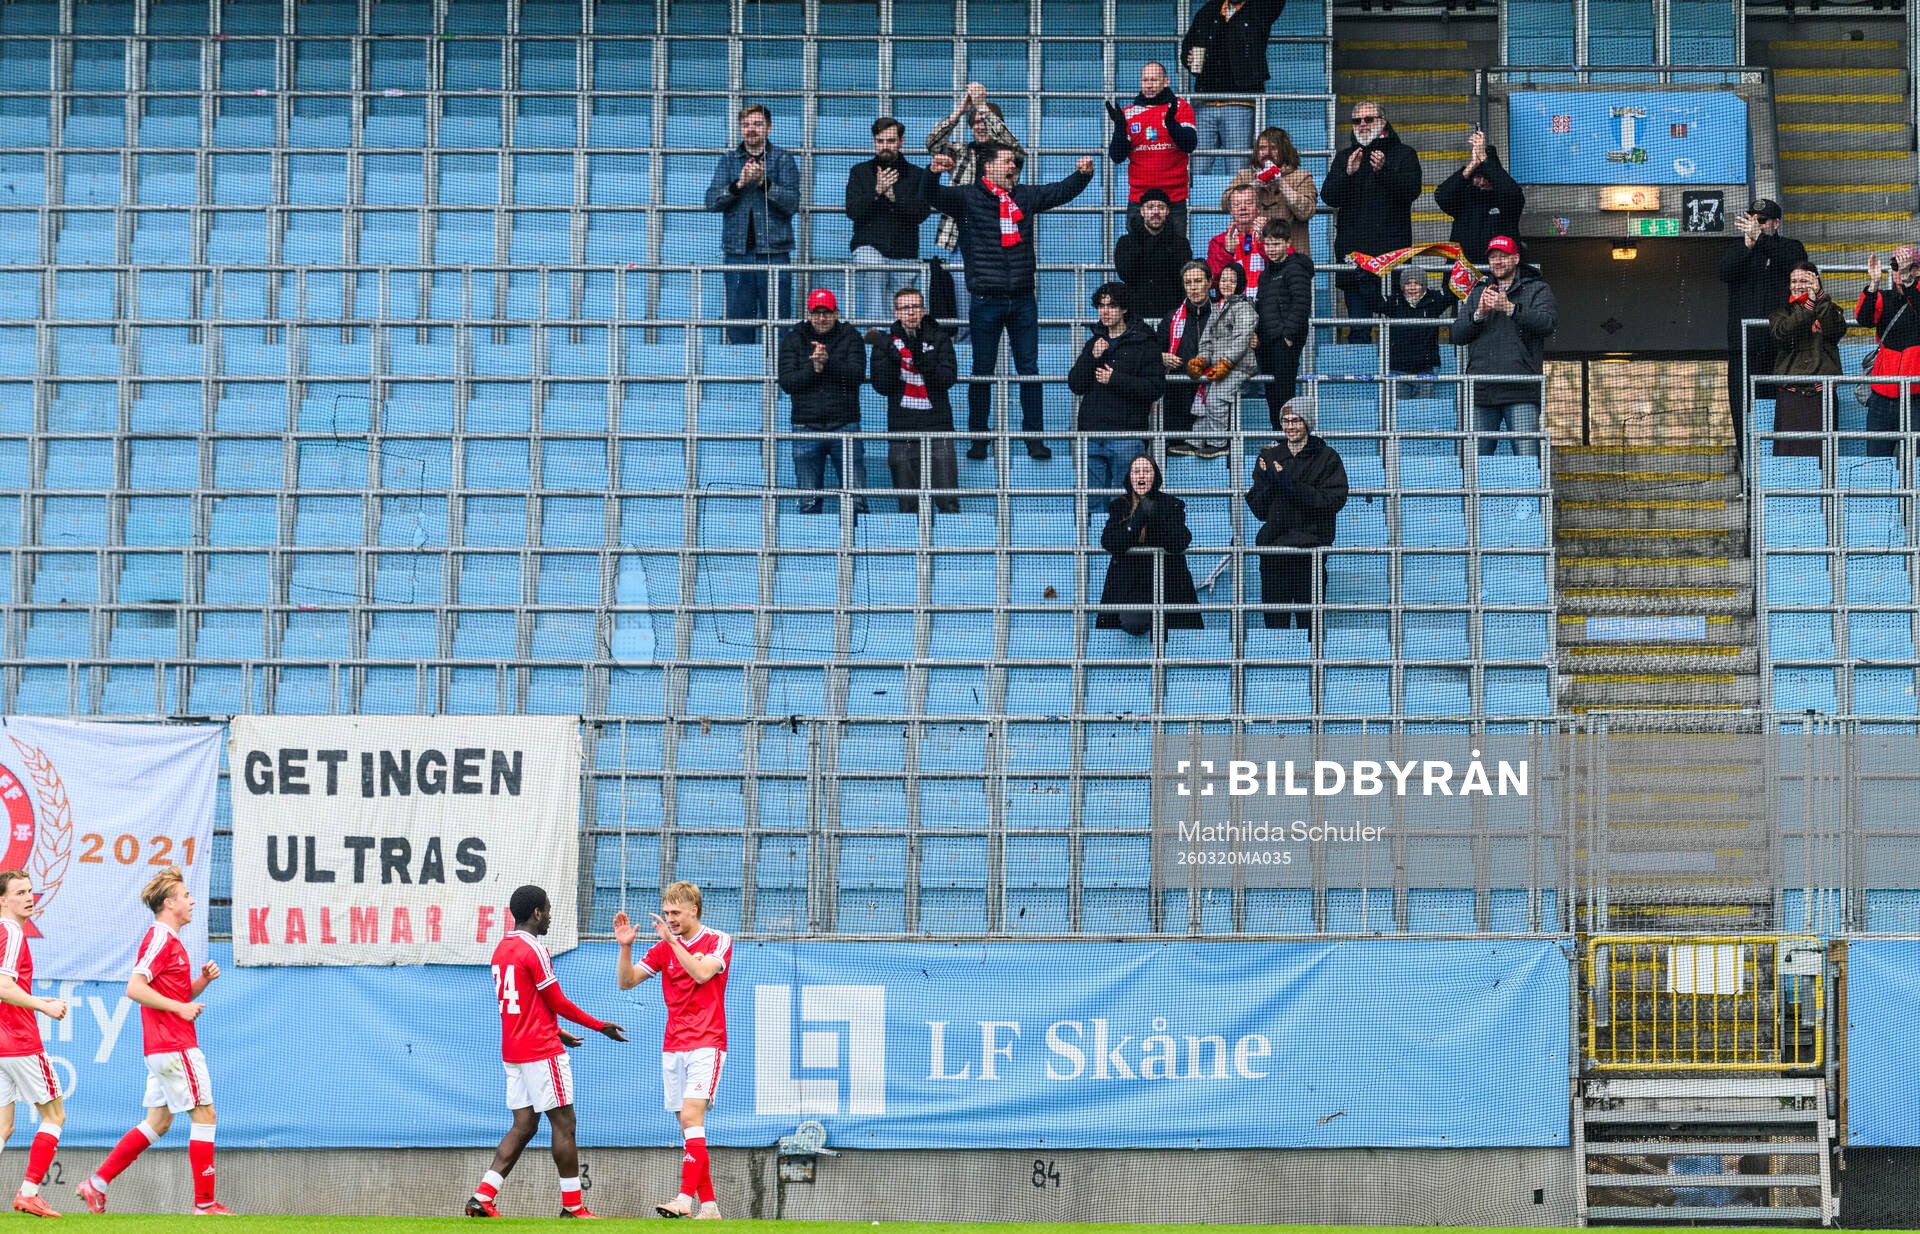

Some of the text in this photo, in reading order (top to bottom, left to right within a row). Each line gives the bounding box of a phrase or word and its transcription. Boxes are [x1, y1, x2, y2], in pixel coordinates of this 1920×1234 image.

[1687, 199, 1719, 223] 17
[79, 833, 195, 866] 2021
[267, 835, 487, 884] ULTRAS
[249, 905, 442, 944] KALMAR
[36, 980, 134, 1064] ify
[926, 1017, 1272, 1081] LF Skåne
[1032, 1160, 1060, 1188] 84
